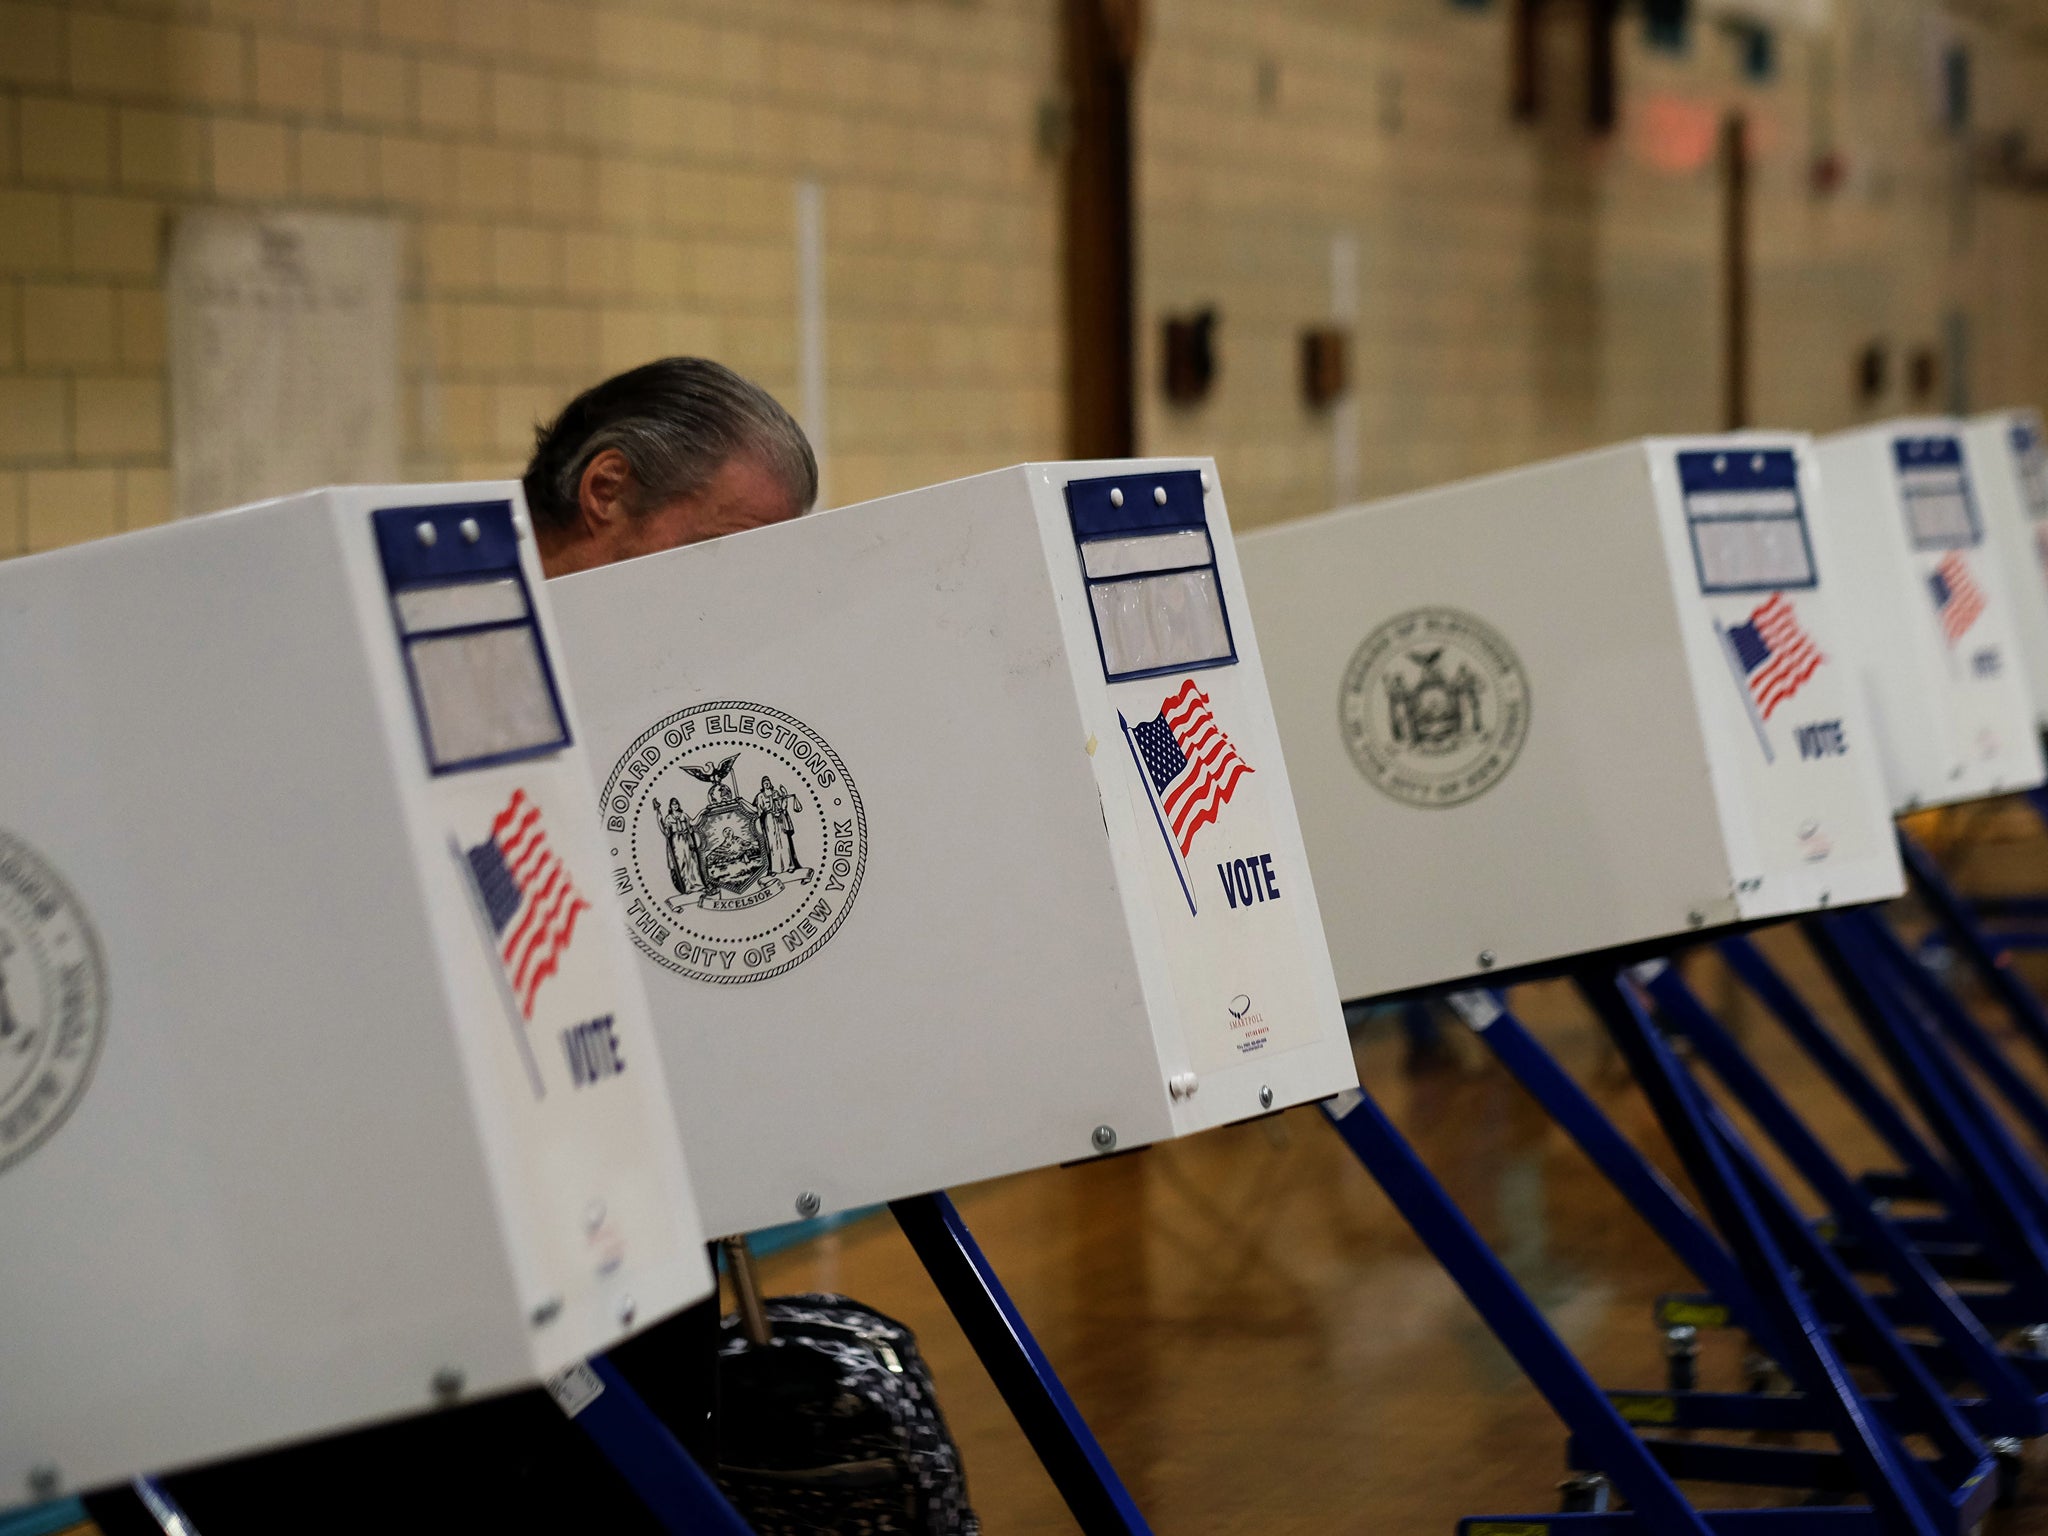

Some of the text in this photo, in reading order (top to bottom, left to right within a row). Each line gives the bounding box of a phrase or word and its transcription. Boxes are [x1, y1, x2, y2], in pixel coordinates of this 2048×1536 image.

[607, 714, 836, 833] BOARD OF ELECTIONS
[611, 819, 852, 969] IN THE CITY OF NEW YORK
[712, 889, 773, 910] EXCELSIOR
[1217, 853, 1281, 909] VOTE
